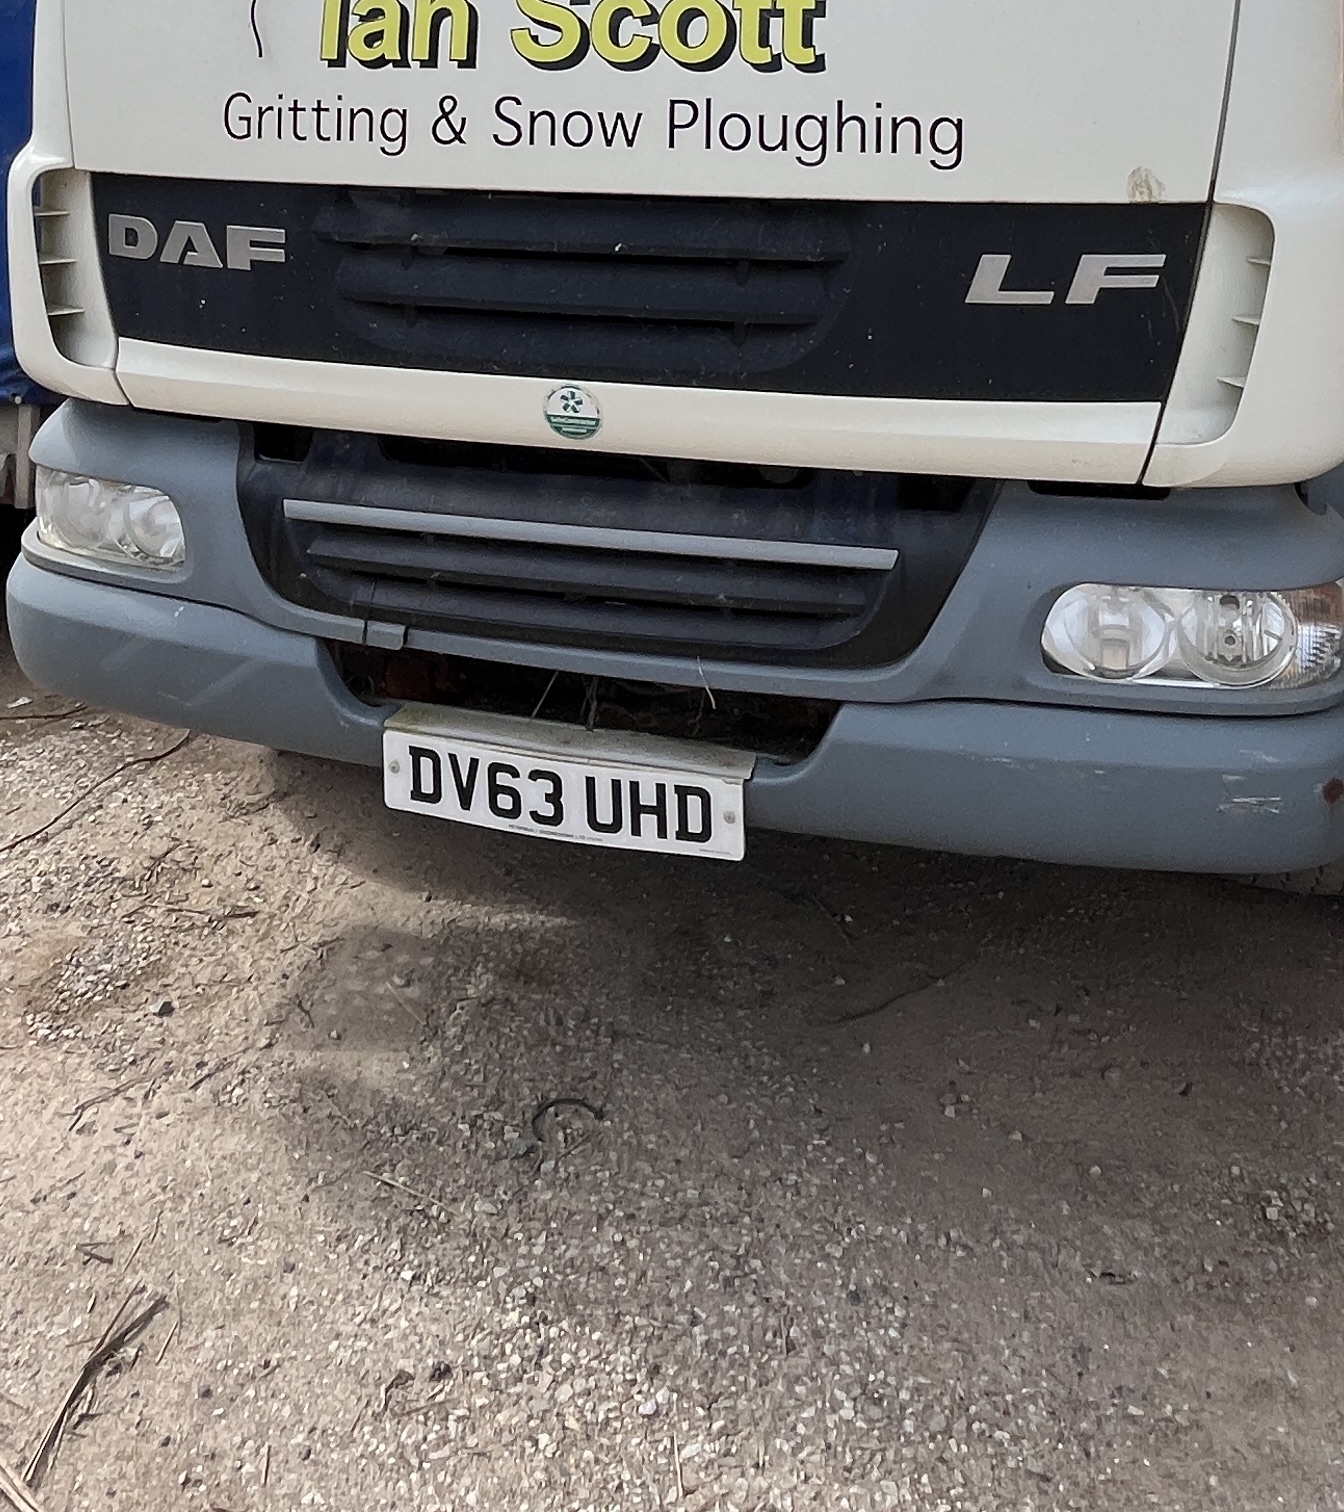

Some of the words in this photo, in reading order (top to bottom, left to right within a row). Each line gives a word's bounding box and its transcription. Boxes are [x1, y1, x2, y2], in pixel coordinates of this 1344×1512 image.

[223, 92, 408, 156] Gritting
[432, 96, 466, 144] &
[493, 98, 643, 148] Snow
[668, 100, 964, 169] Ploughing
[108, 214, 285, 270] DAF
[965, 254, 1167, 305] LF
[409, 745, 564, 827] DV63
[586, 777, 713, 843] UHD
